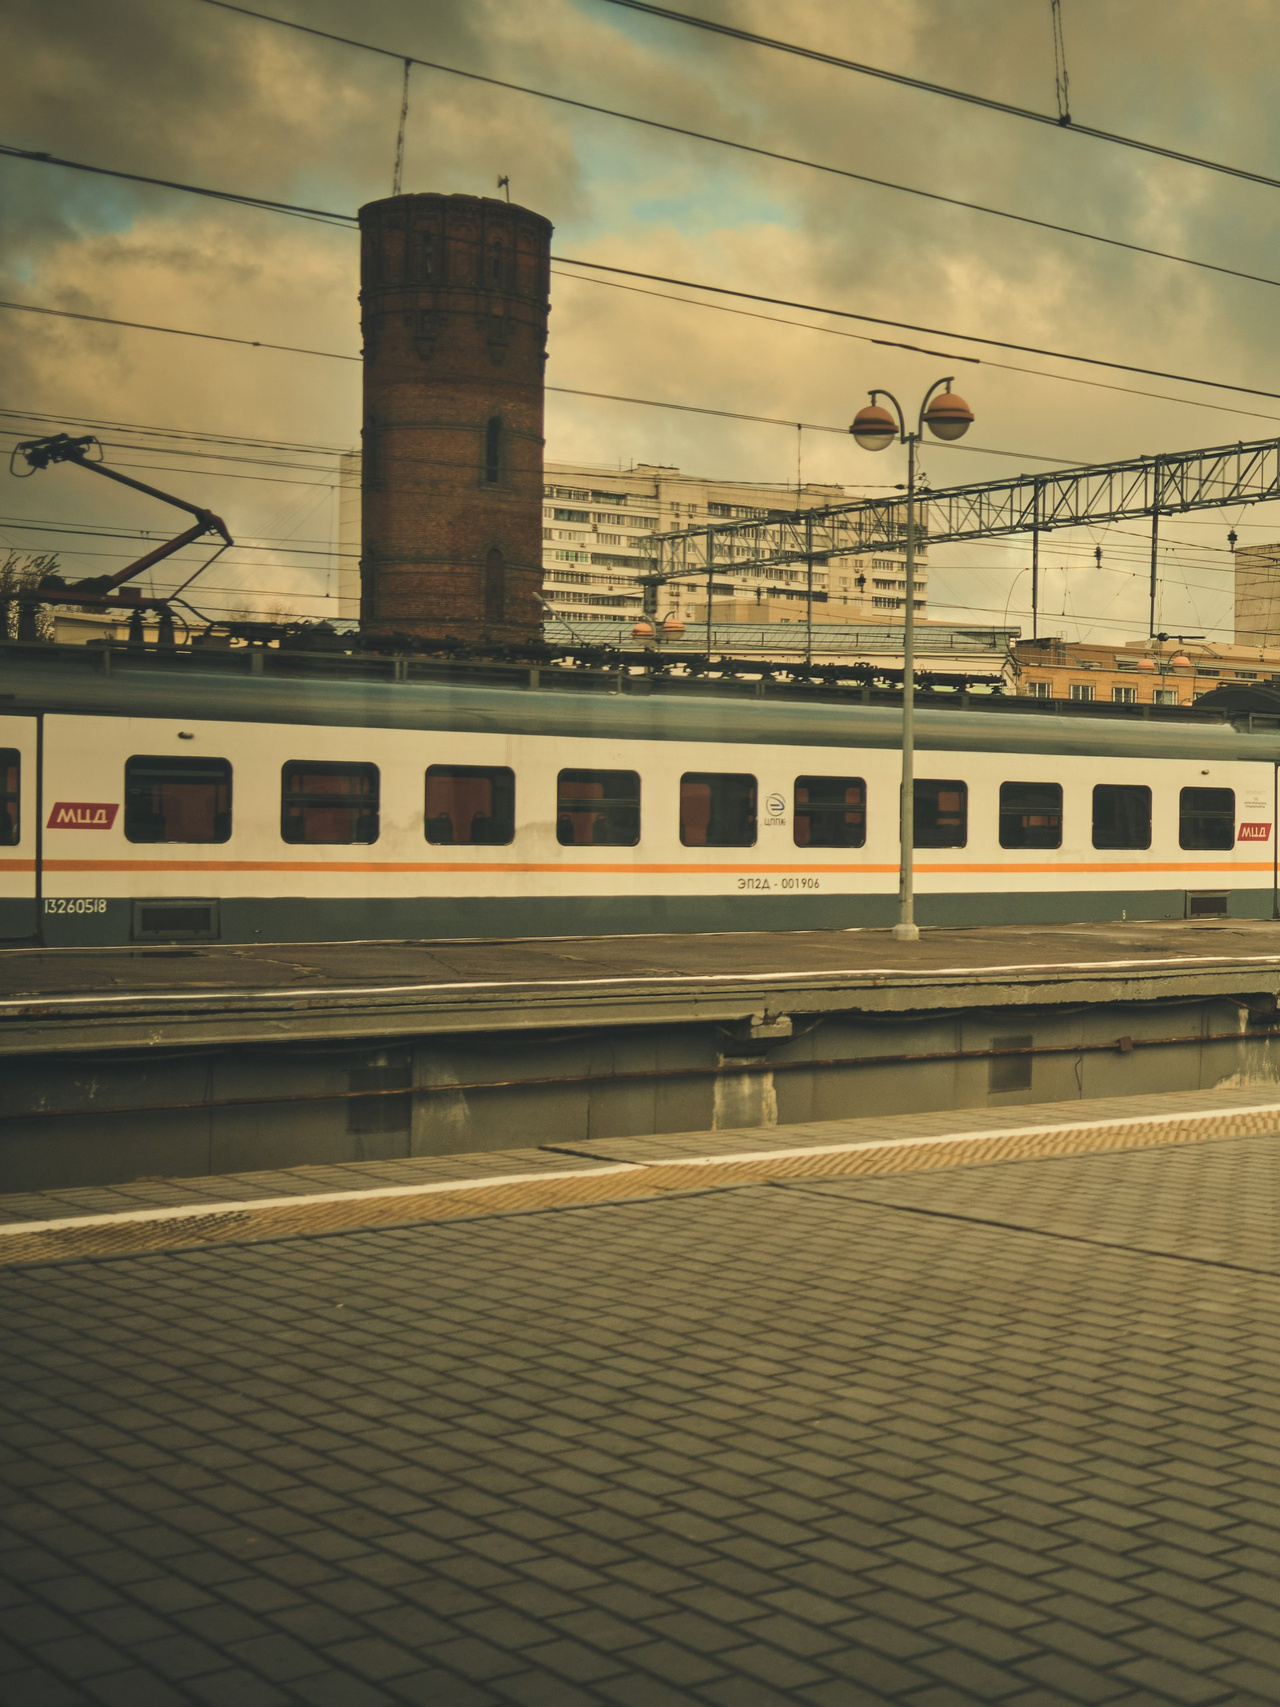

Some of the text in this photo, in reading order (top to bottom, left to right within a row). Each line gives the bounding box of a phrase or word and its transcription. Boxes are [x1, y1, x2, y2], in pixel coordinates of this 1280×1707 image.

[56, 808, 108, 824] МЦД
[1242, 827, 1266, 837] МЦД
[737, 877, 770, 890] ЭП2Д
[781, 877, 820, 889] 001906
[44, 899, 107, 914] 13260518
